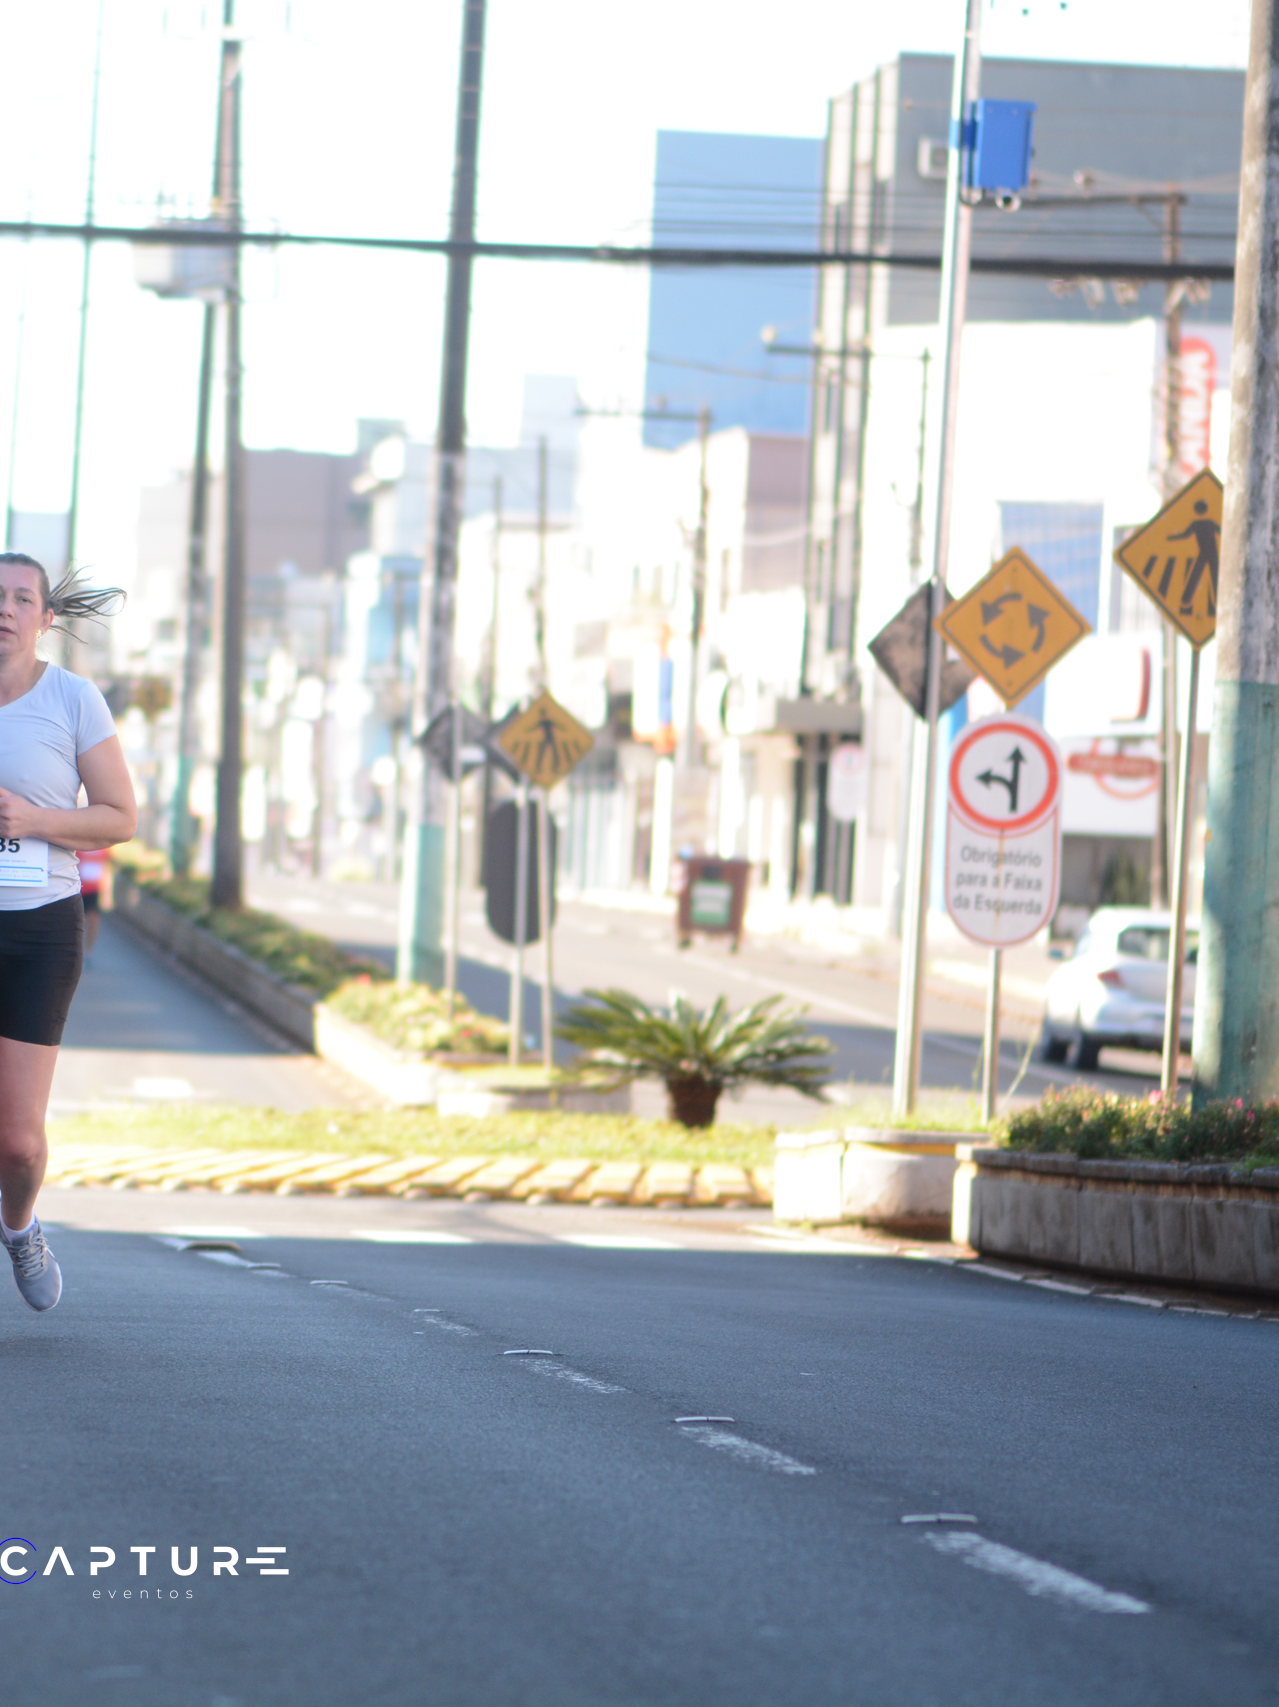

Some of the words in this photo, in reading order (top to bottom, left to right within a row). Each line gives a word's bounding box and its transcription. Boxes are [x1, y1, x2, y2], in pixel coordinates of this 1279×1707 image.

[961, 844, 1042, 868] Obrigatório
[956, 871, 987, 888] para
[991, 875, 1000, 888] a
[1004, 873, 1042, 891] Faixa
[953, 894, 970, 910] da
[974, 895, 1042, 916] Esquerda
